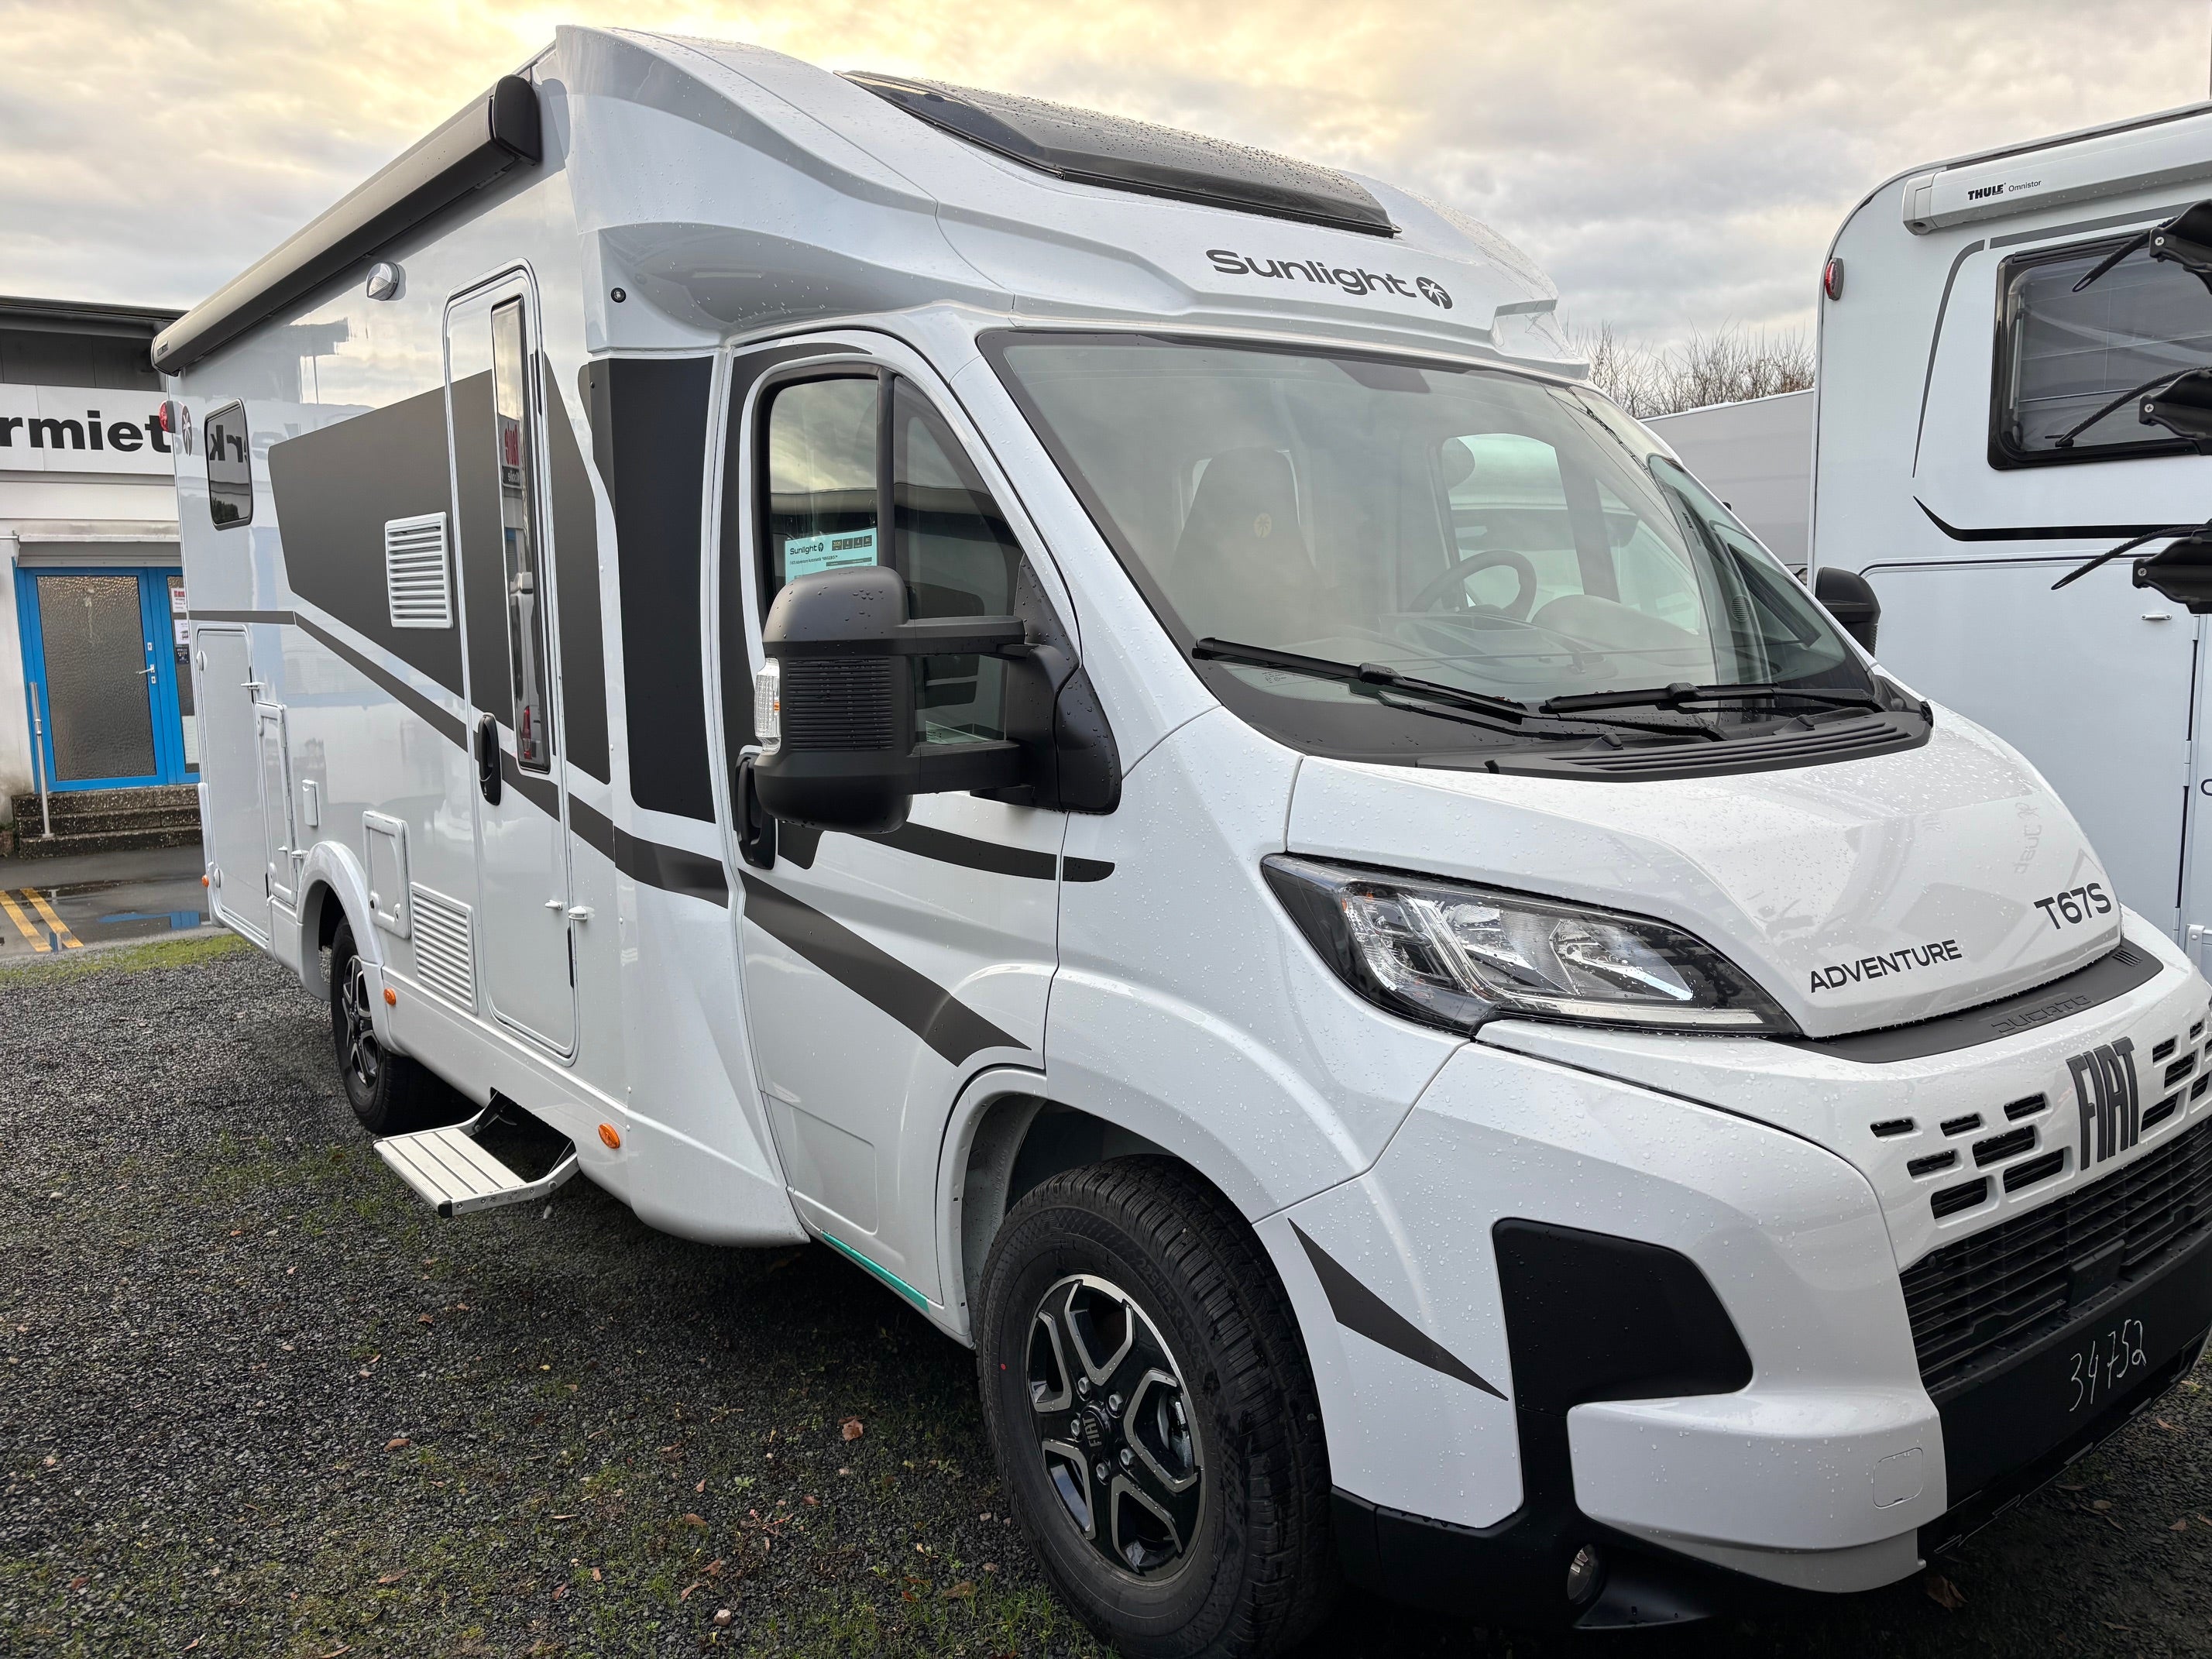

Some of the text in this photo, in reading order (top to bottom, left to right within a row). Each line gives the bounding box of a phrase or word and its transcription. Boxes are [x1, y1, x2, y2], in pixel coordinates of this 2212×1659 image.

[1968, 180, 2042, 201] THULE Omnistor
[1206, 249, 1417, 296] Sunlight
[790, 544, 817, 555] Sunlight
[2034, 883, 2112, 929] T67S
[1810, 939, 1962, 993] ADVENTURE
[1990, 995, 2092, 1033] DUCATO
[2066, 1036, 2139, 1171] FIAT
[1139, 1258, 1175, 1306] 225/75
[2069, 1319, 2147, 1412] 34752
[1082, 1417, 1102, 1447] FIAT
